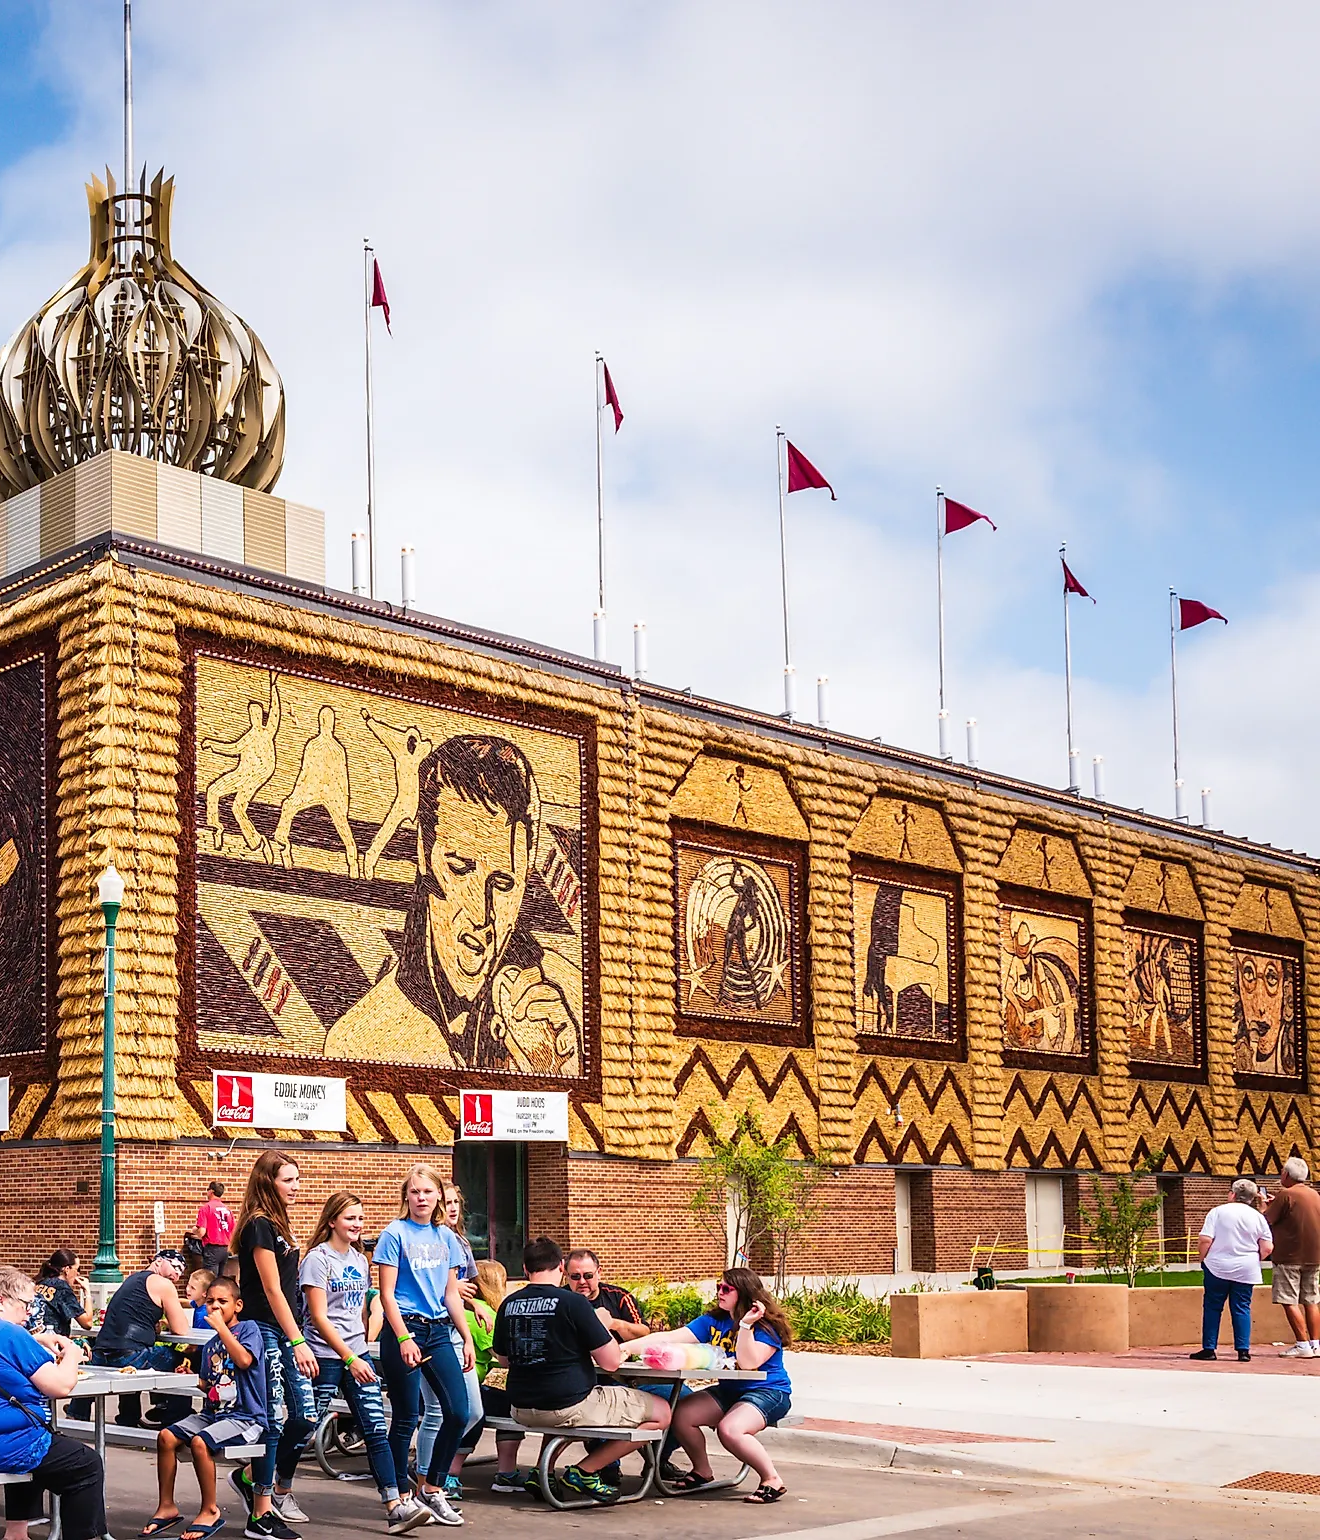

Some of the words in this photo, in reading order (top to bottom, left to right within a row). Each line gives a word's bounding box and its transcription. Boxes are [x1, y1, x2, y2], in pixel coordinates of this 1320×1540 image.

[274, 1081, 297, 1099] EDDIE
[299, 1083, 326, 1100] MONEY
[218, 1105, 253, 1120] Coca-Cola
[464, 1121, 492, 1134] Coca-Cola
[505, 1297, 559, 1317] MUSTANGS
